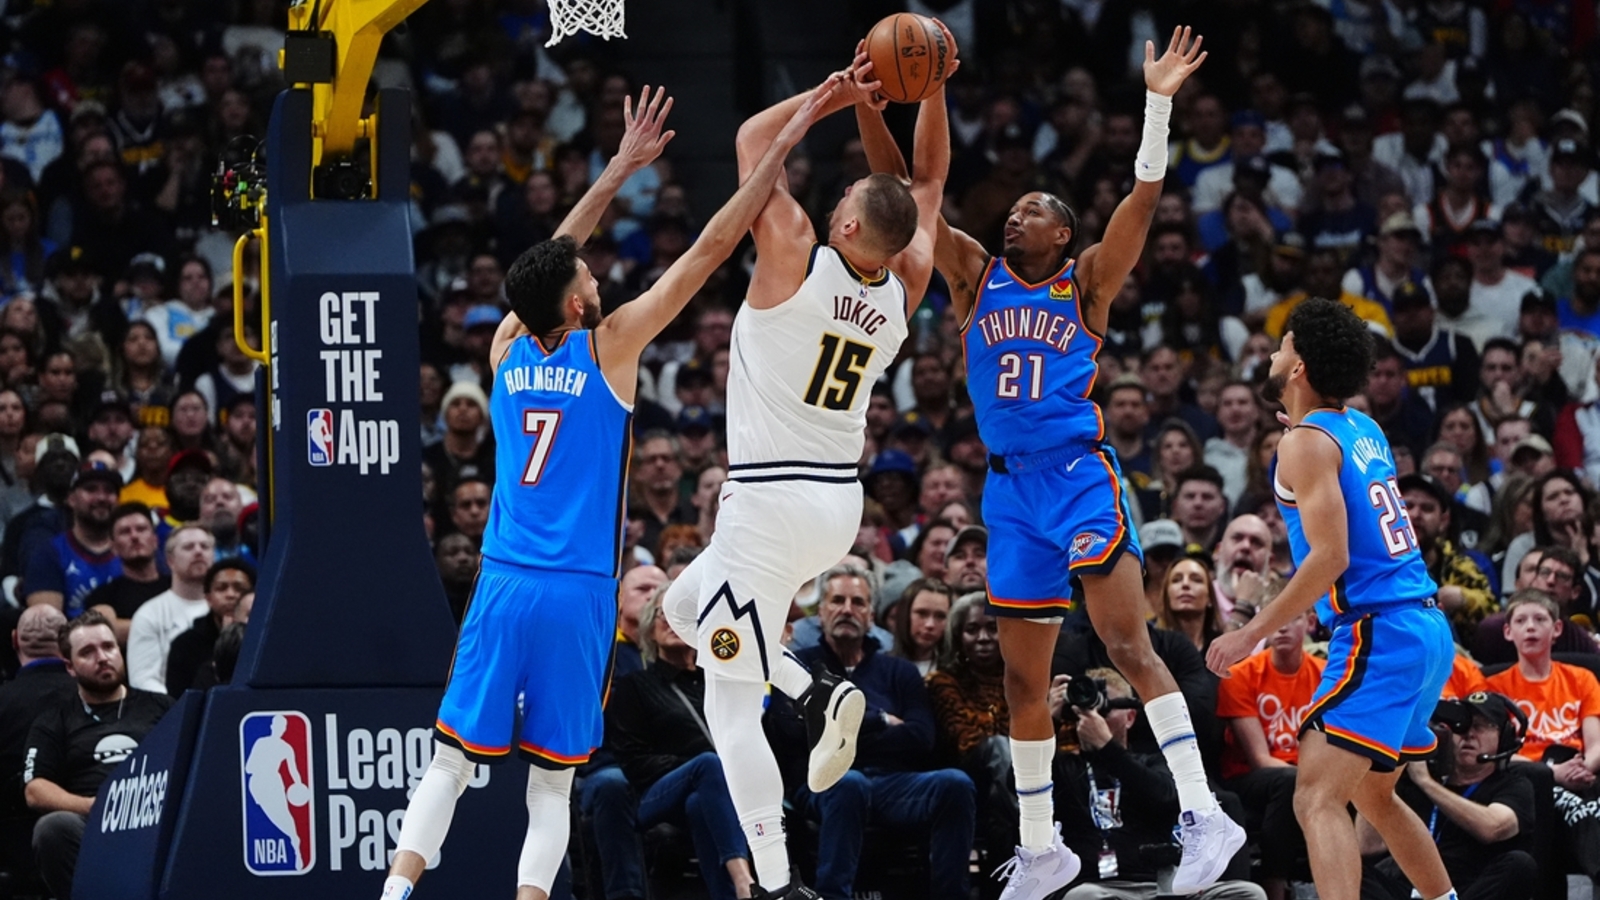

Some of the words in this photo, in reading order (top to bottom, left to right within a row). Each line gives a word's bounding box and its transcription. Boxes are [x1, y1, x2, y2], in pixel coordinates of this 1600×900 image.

[319, 292, 380, 345] GET
[833, 295, 888, 336] JOKIC
[978, 307, 1077, 352] THUNDER
[320, 350, 383, 402] THE
[504, 365, 588, 397] HOLMGREN
[803, 332, 876, 411] 15
[997, 353, 1043, 399] 21
[338, 410, 400, 475] App
[521, 409, 562, 485] 7
[1367, 476, 1419, 558] 25
[325, 713, 490, 800] Leag
[101, 754, 168, 833] coinbase
[254, 838, 288, 864] NBA
[854, 890, 882, 900] LUB
